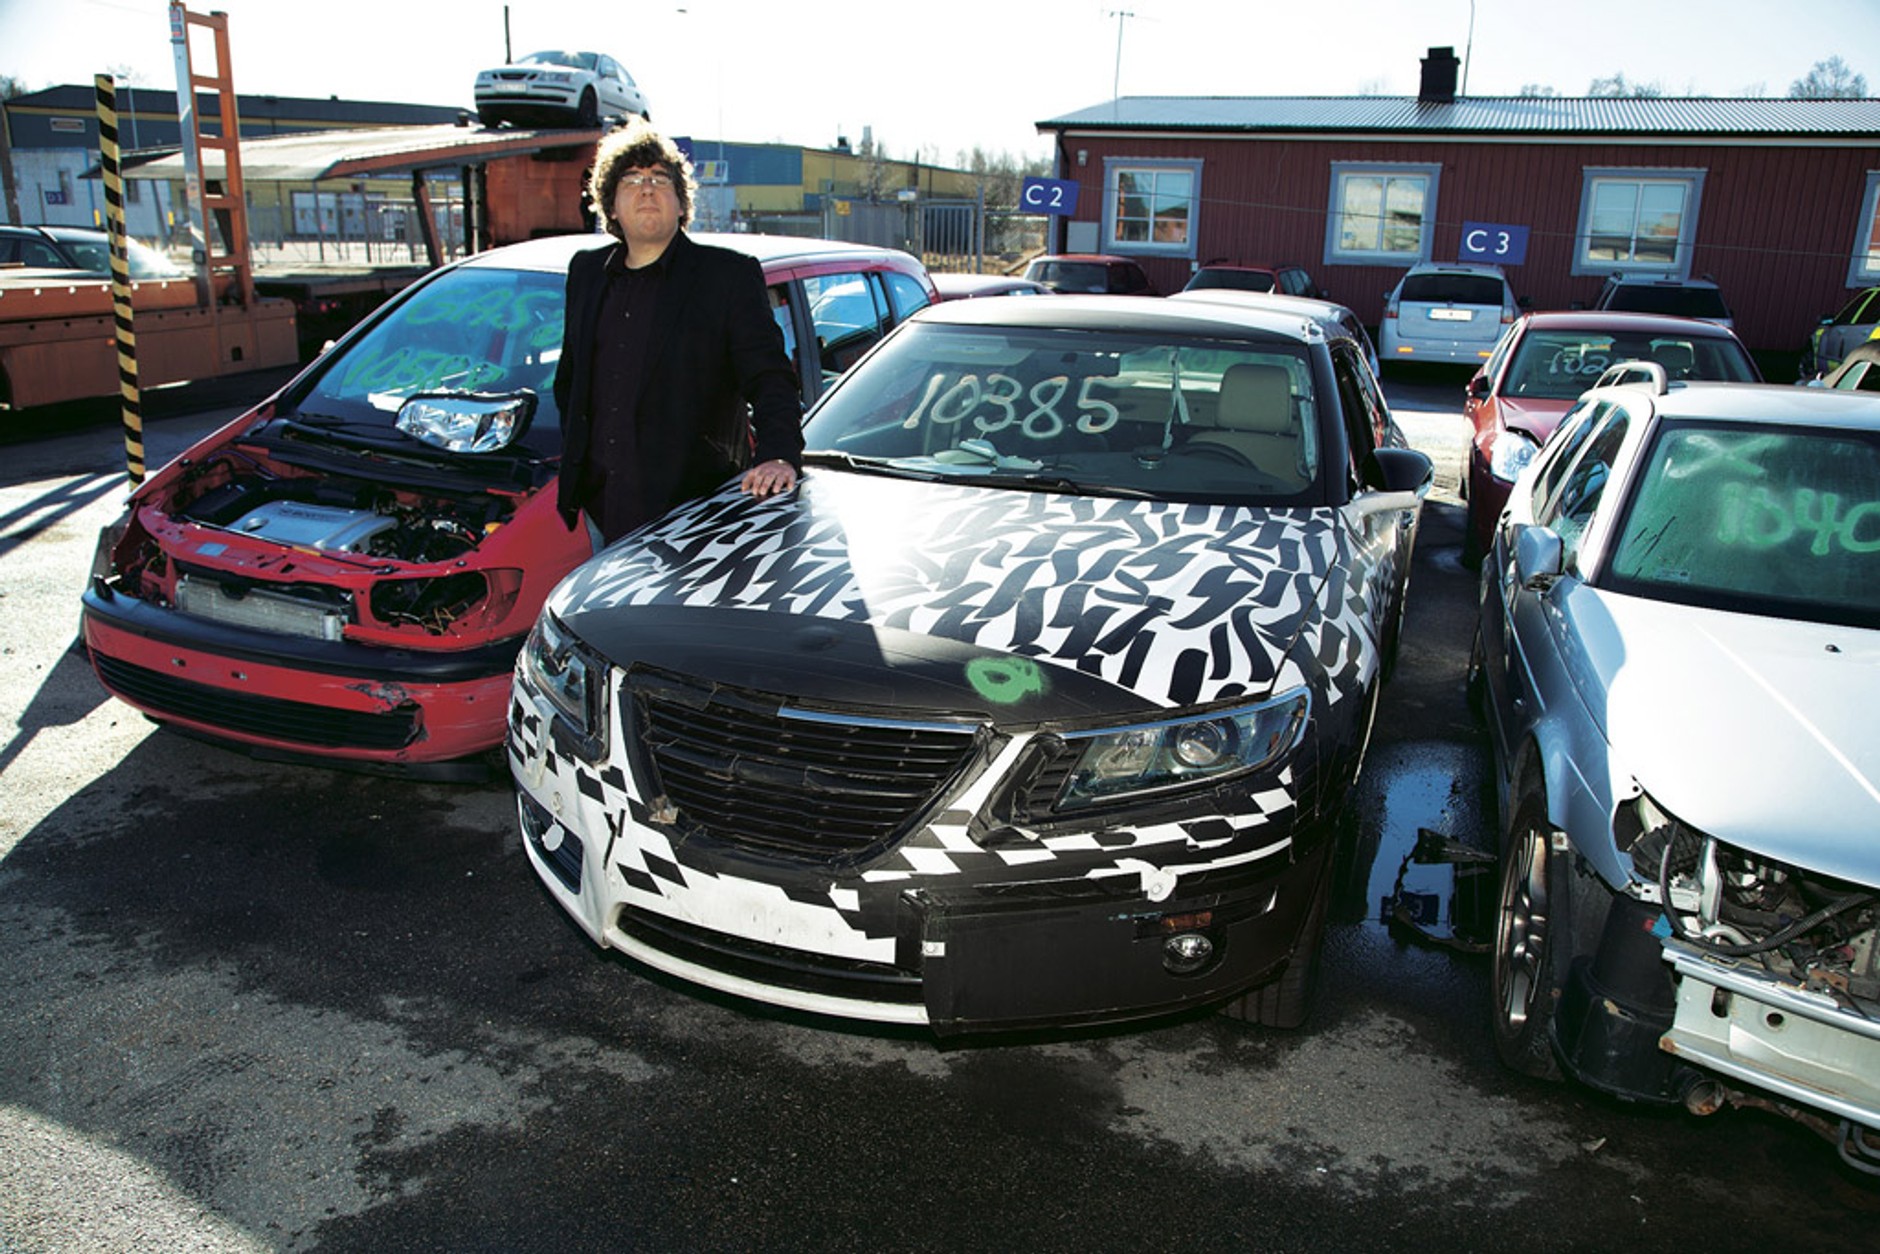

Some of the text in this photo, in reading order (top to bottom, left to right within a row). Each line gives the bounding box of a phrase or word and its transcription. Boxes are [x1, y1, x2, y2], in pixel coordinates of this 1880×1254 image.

[1026, 185, 1062, 207] C 2
[1466, 230, 1510, 254] C 3
[903, 373, 1119, 439] 10385
